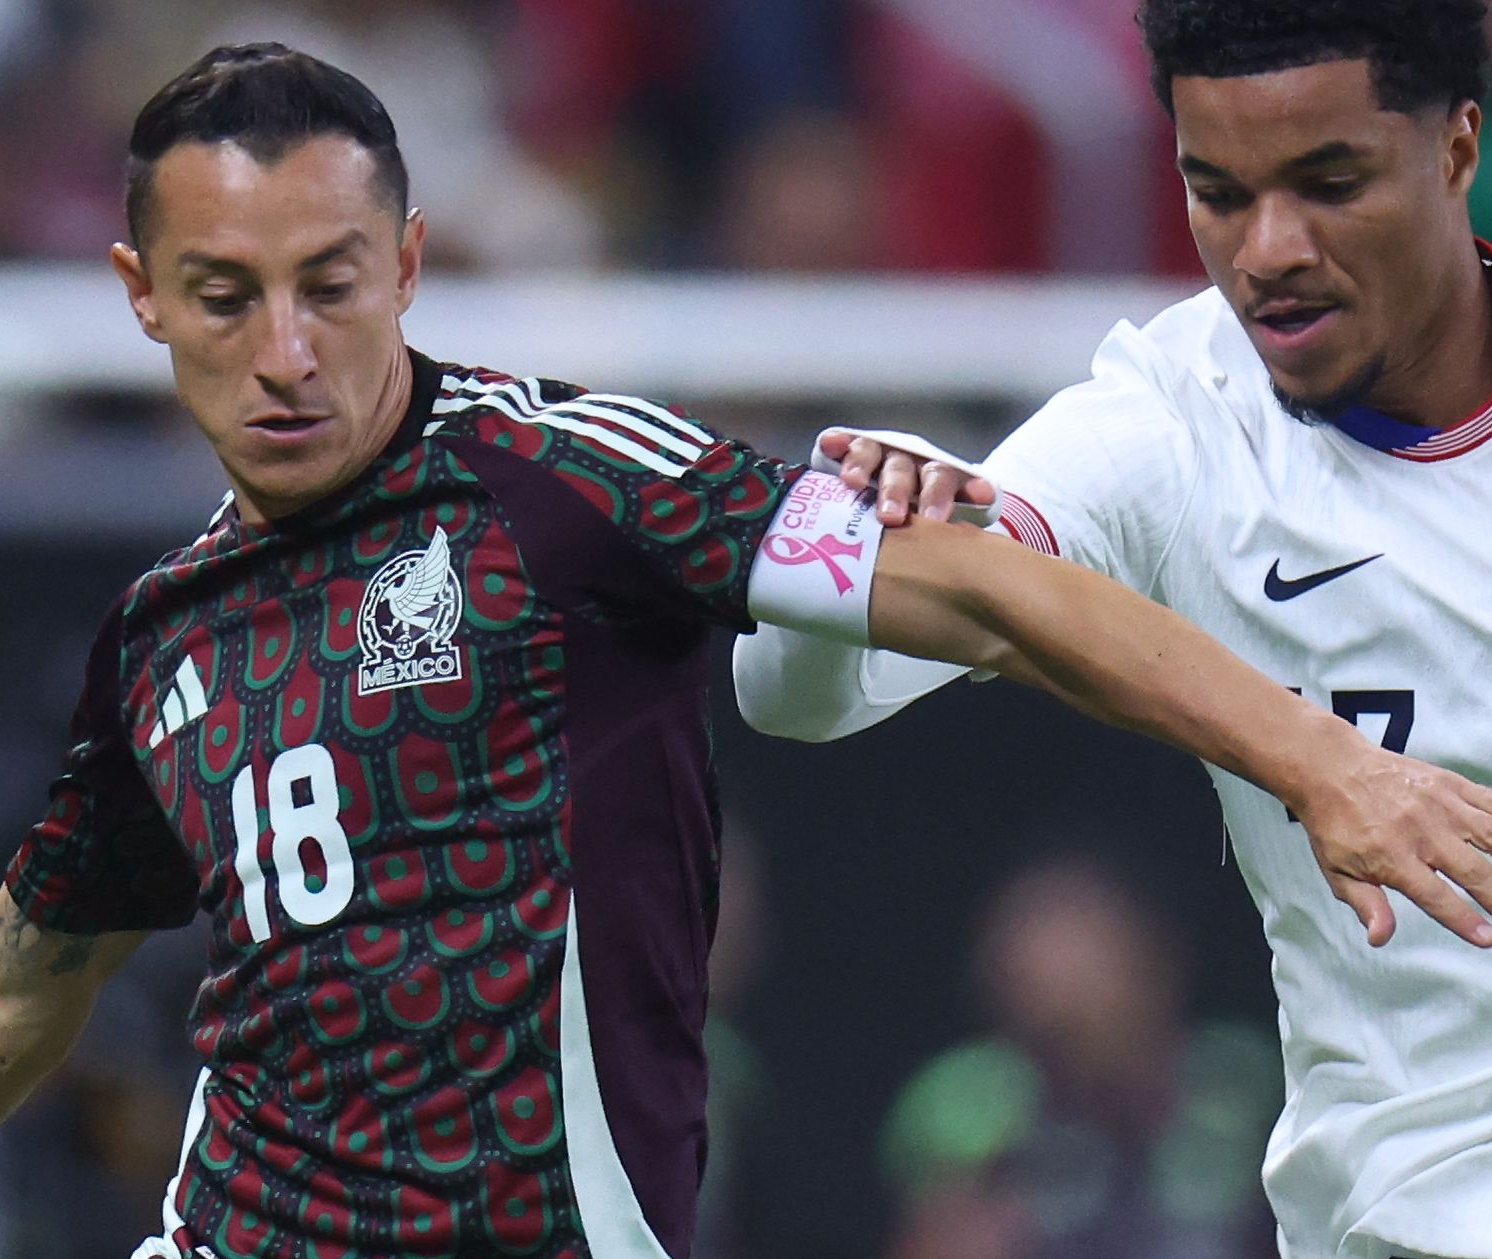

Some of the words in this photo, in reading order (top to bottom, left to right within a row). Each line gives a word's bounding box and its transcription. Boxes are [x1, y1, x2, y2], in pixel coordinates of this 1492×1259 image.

[816, 478, 843, 501] DEC
[362, 655, 455, 689] MÉXICO
[232, 743, 355, 944] 18
